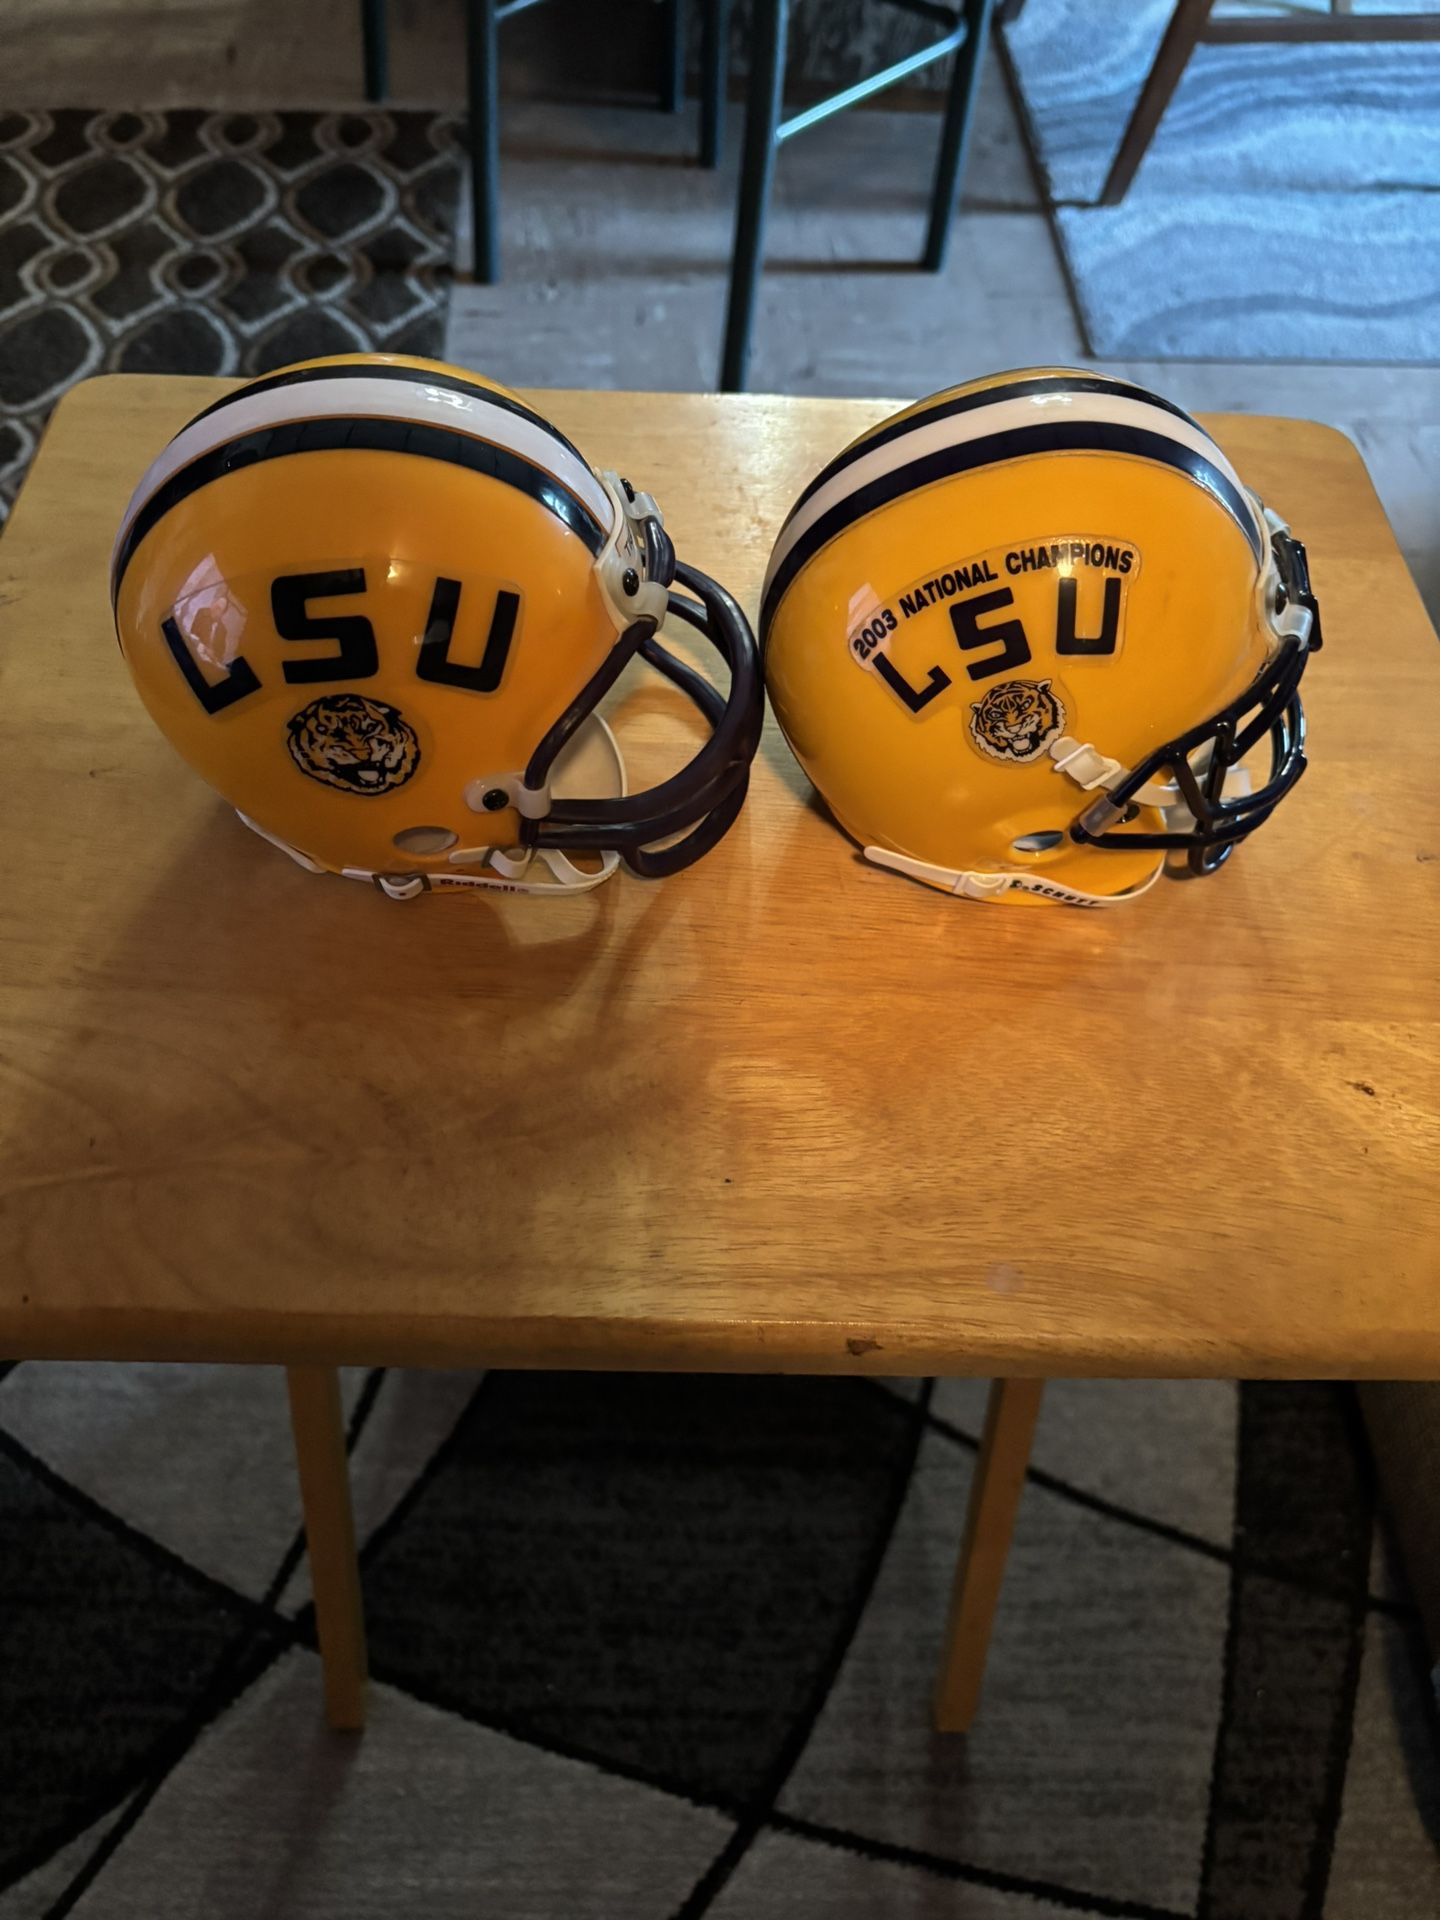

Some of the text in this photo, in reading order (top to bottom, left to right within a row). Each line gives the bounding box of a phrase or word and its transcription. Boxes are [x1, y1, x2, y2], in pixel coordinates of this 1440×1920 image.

[162, 568, 520, 714] LSU
[853, 543, 1134, 660] 2003 NATIONAL CHAMPIONS
[872, 577, 1121, 713] LSU
